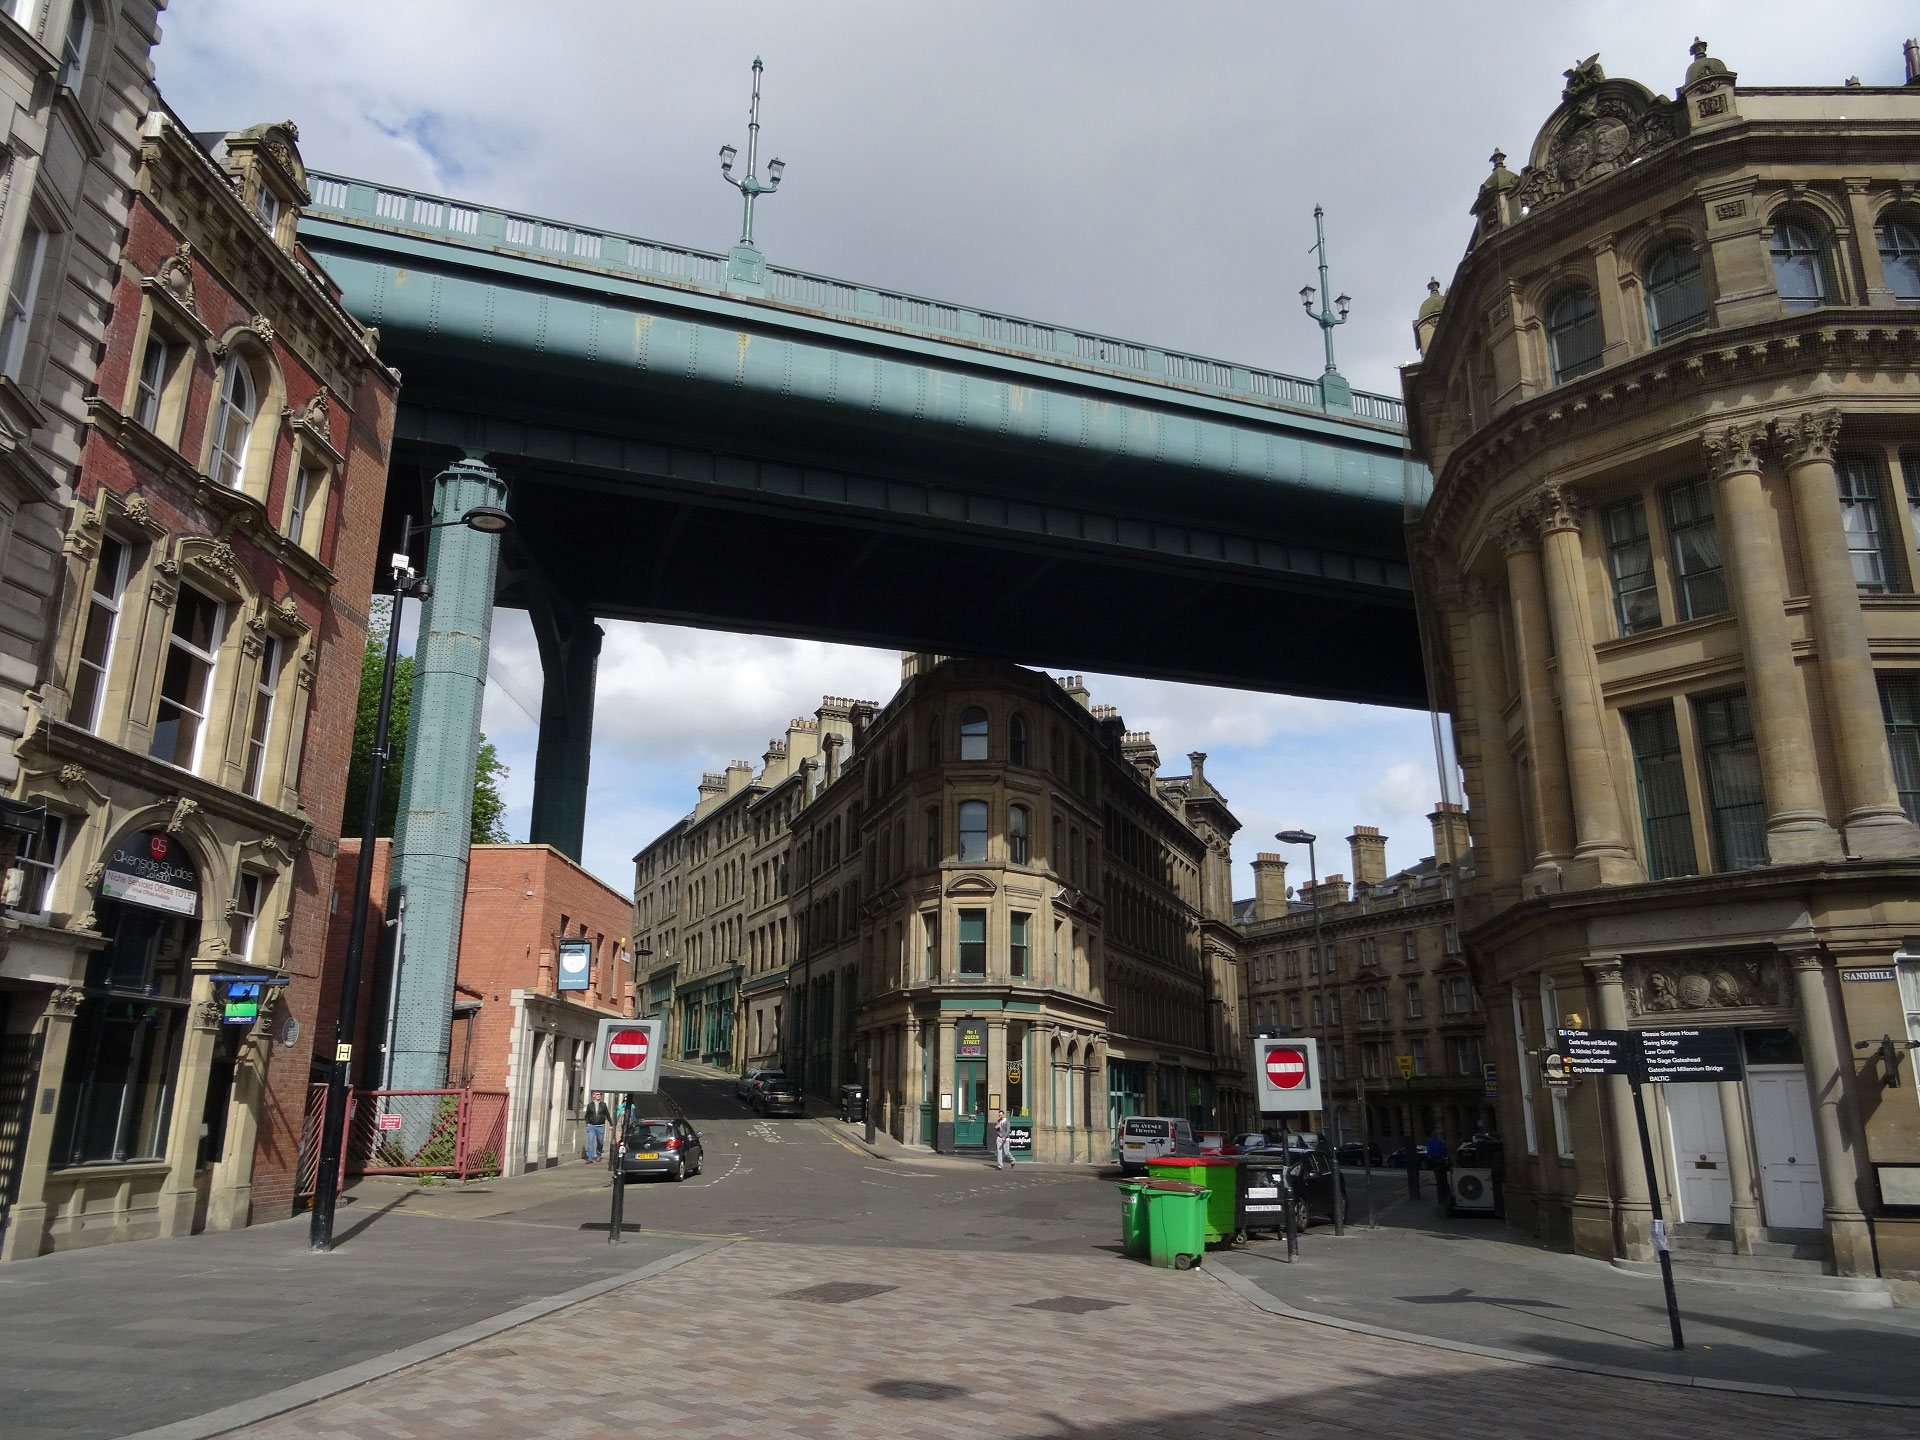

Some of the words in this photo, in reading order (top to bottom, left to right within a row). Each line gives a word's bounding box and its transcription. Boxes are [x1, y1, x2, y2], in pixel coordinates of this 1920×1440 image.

[161, 862, 194, 882] Studios
[108, 872, 126, 884] Niche
[128, 877, 153, 890] Serviced
[154, 884, 173, 896] Offices
[1843, 972, 1893, 980] SANDHILL
